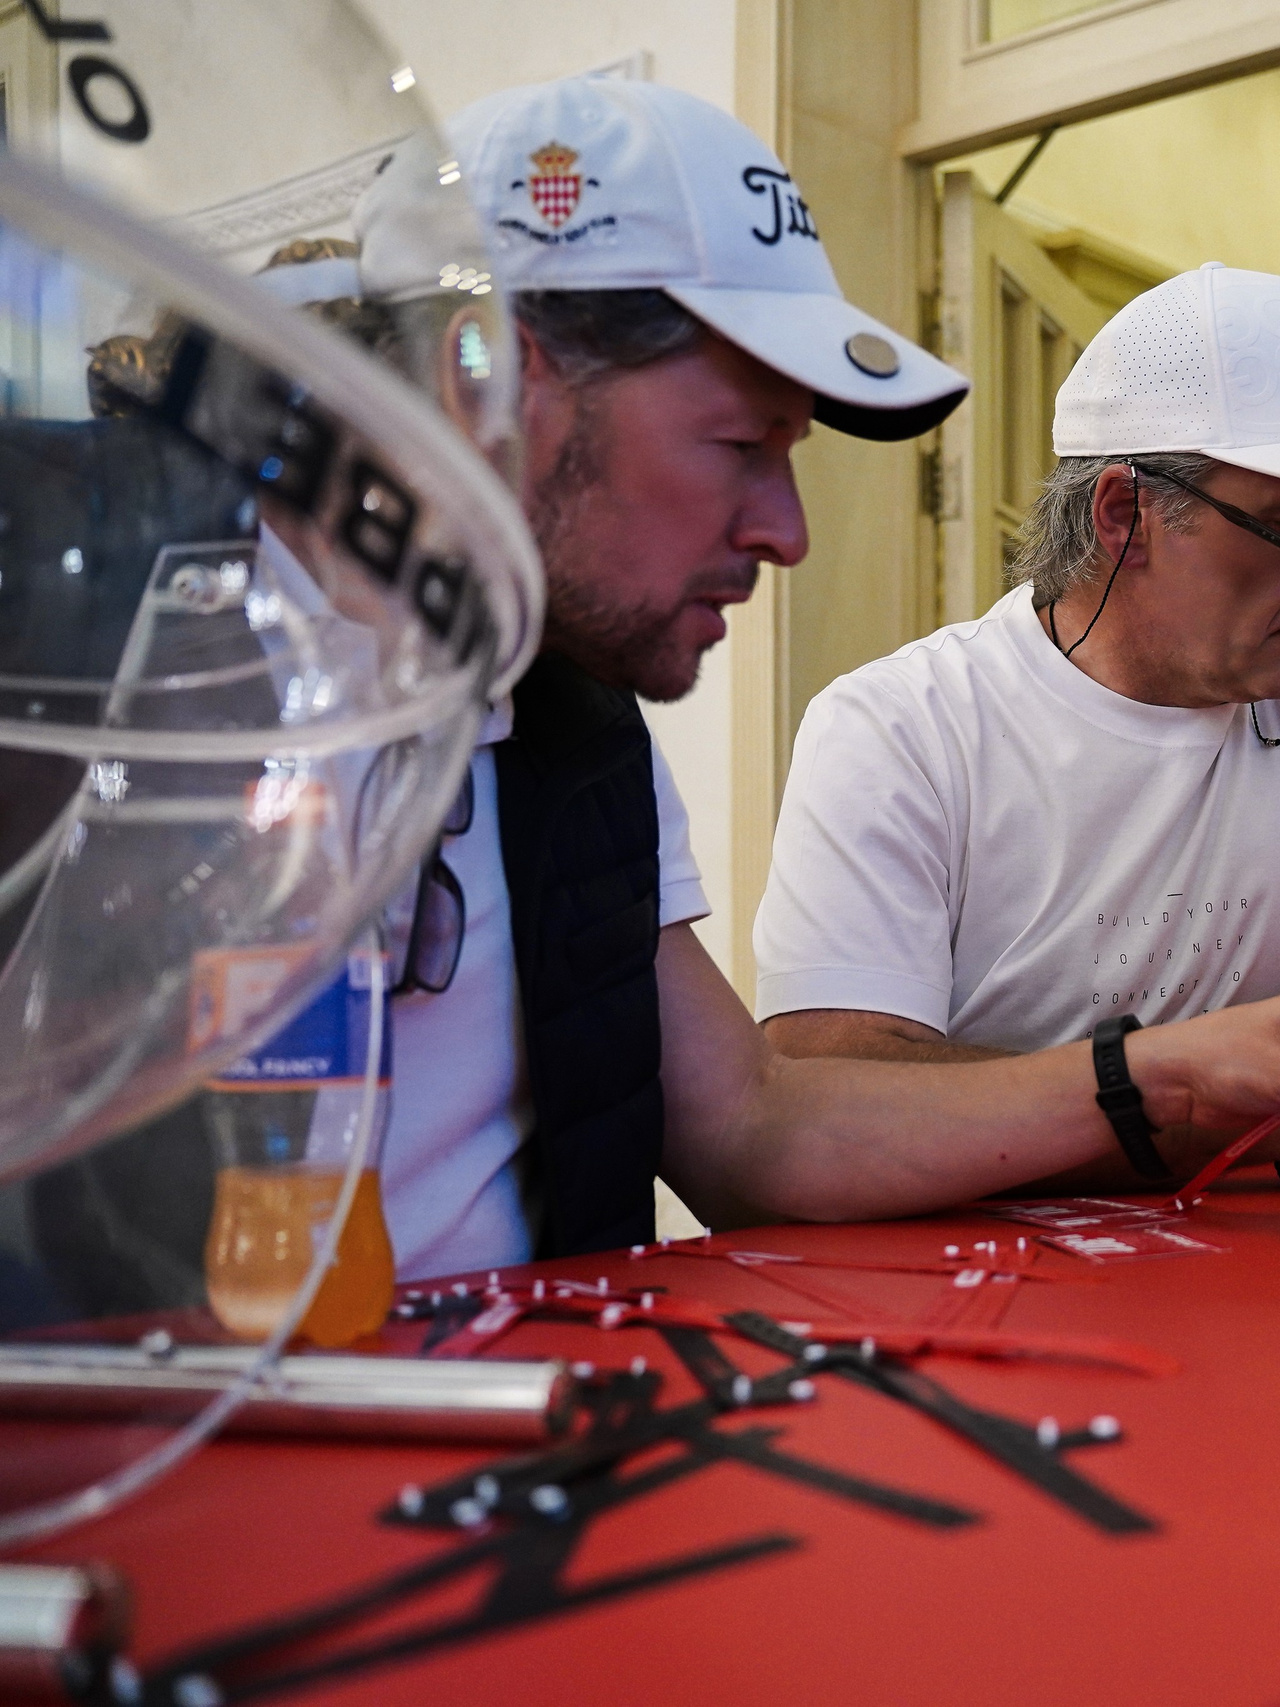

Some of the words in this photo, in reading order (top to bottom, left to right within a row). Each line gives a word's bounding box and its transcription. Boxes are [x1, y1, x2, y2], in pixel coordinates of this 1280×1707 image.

[742, 166, 820, 246] Tit
[1097, 911, 1170, 926] BUILD
[1187, 898, 1248, 918] YOUR
[1093, 935, 1244, 964] JOURNEY
[1092, 979, 1199, 1005] CONNECT
